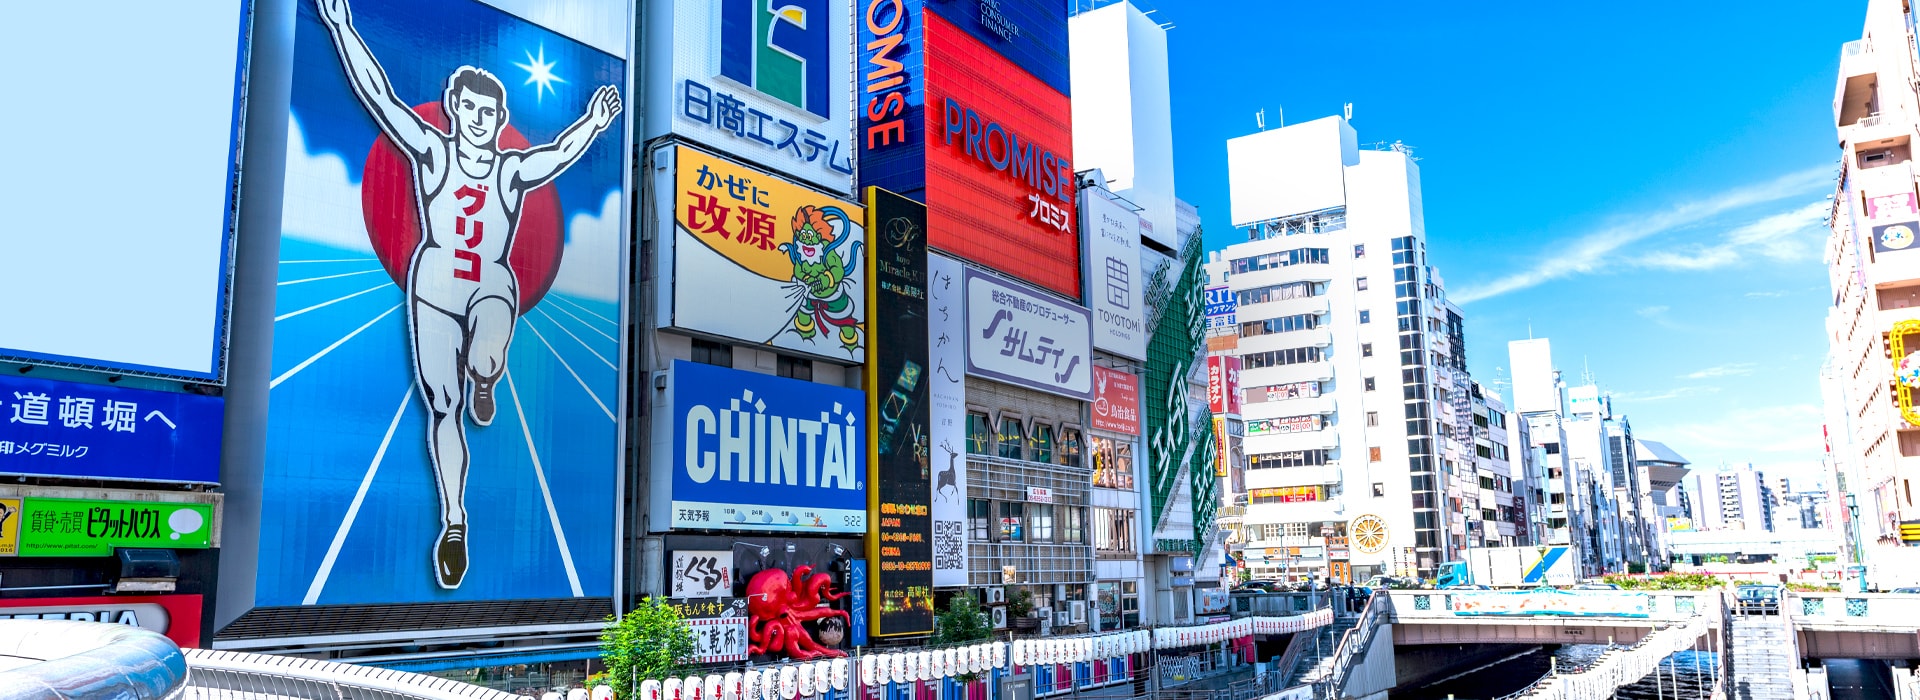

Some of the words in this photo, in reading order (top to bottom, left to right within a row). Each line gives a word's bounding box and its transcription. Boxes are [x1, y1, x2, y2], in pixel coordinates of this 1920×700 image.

[981, 3, 1020, 37] CONSUMER
[981, 14, 1013, 43] FINANCE
[685, 79, 853, 176] 日商エステム
[944, 97, 1071, 205] PROMISE
[696, 164, 770, 218] かぜに
[453, 183, 489, 283] グリコ
[687, 190, 777, 252] 改源
[1028, 193, 1072, 234] プロミス
[992, 289, 1075, 324] 総合不動産のプロデューサー
[1000, 326, 1064, 369] サムティ
[1210, 365, 1221, 404] カラオケ
[10, 391, 177, 433] 道頓堀へ
[686, 389, 856, 490] CHINTAI
[87, 506, 161, 539] ピタットハウス
[679, 509, 710, 523] 天気予報
[684, 556, 722, 590] くくる
